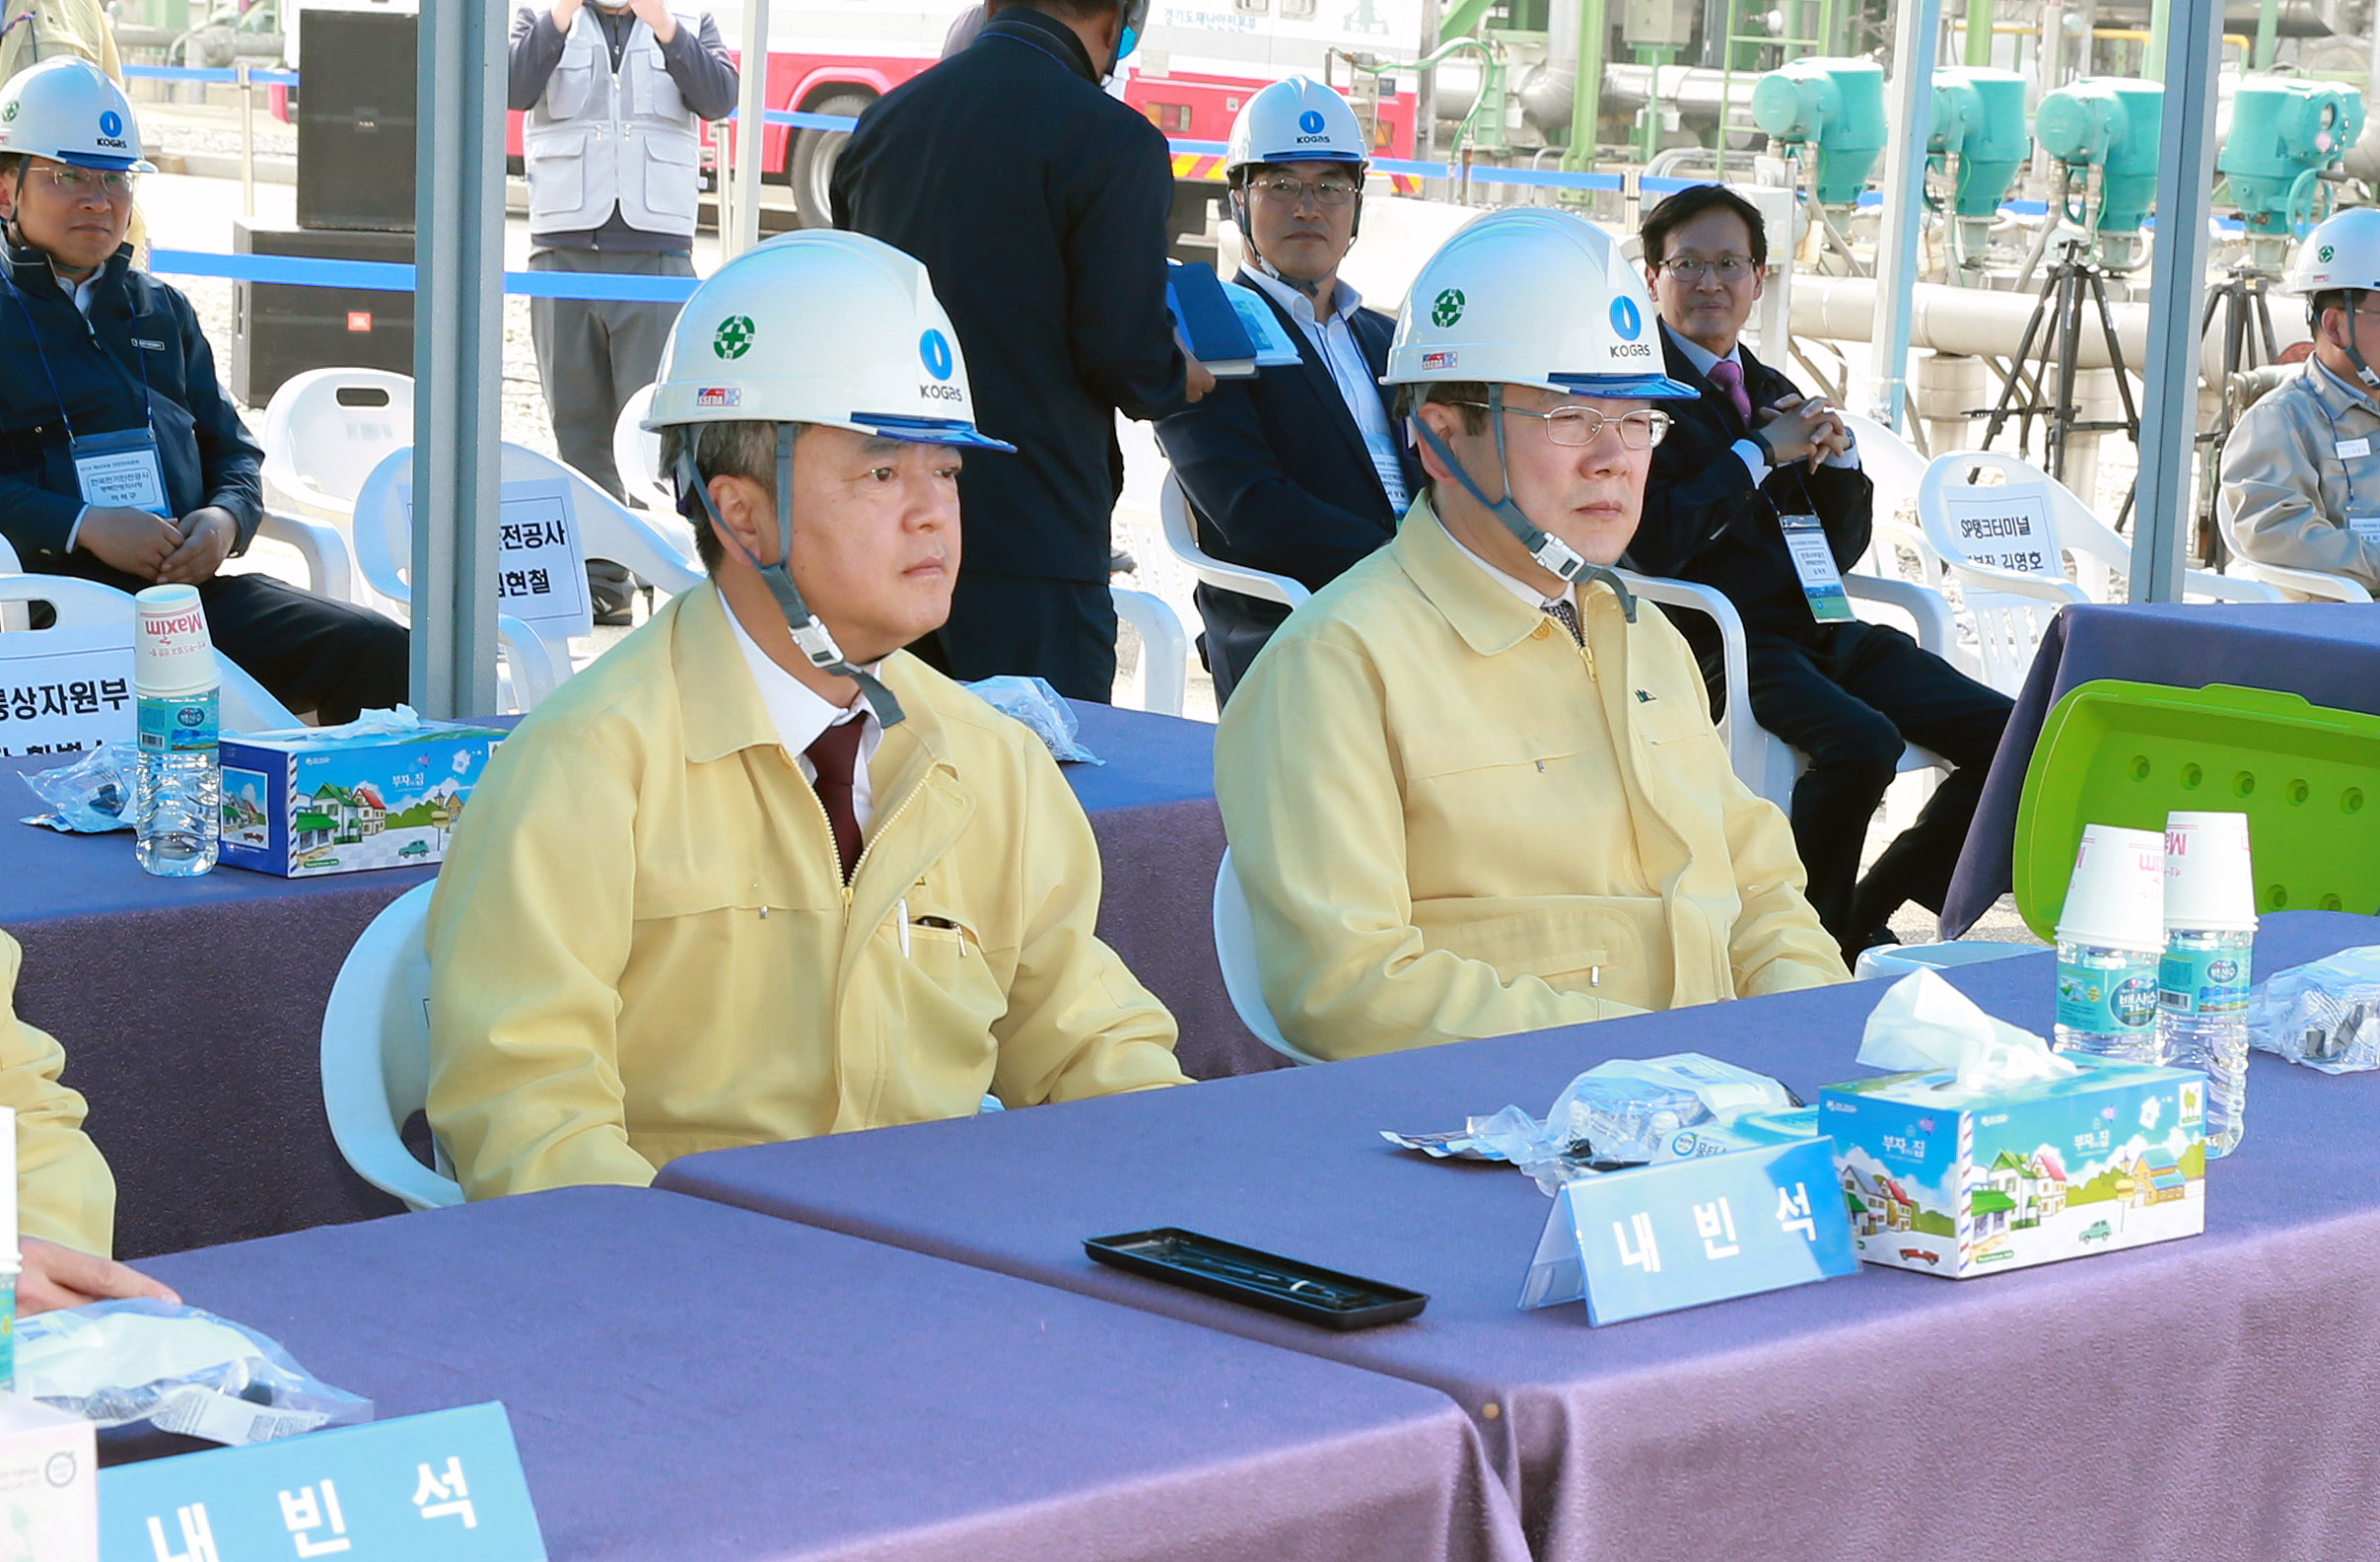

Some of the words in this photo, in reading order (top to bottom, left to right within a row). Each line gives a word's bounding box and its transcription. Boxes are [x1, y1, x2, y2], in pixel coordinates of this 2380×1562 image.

[499, 522, 565, 551] 전공사
[1961, 516, 2031, 539] SP탱크터미널
[2001, 551, 2044, 572] 김영호
[145, 611, 203, 636] Maxim
[2119, 990, 2157, 1012] 백산수
